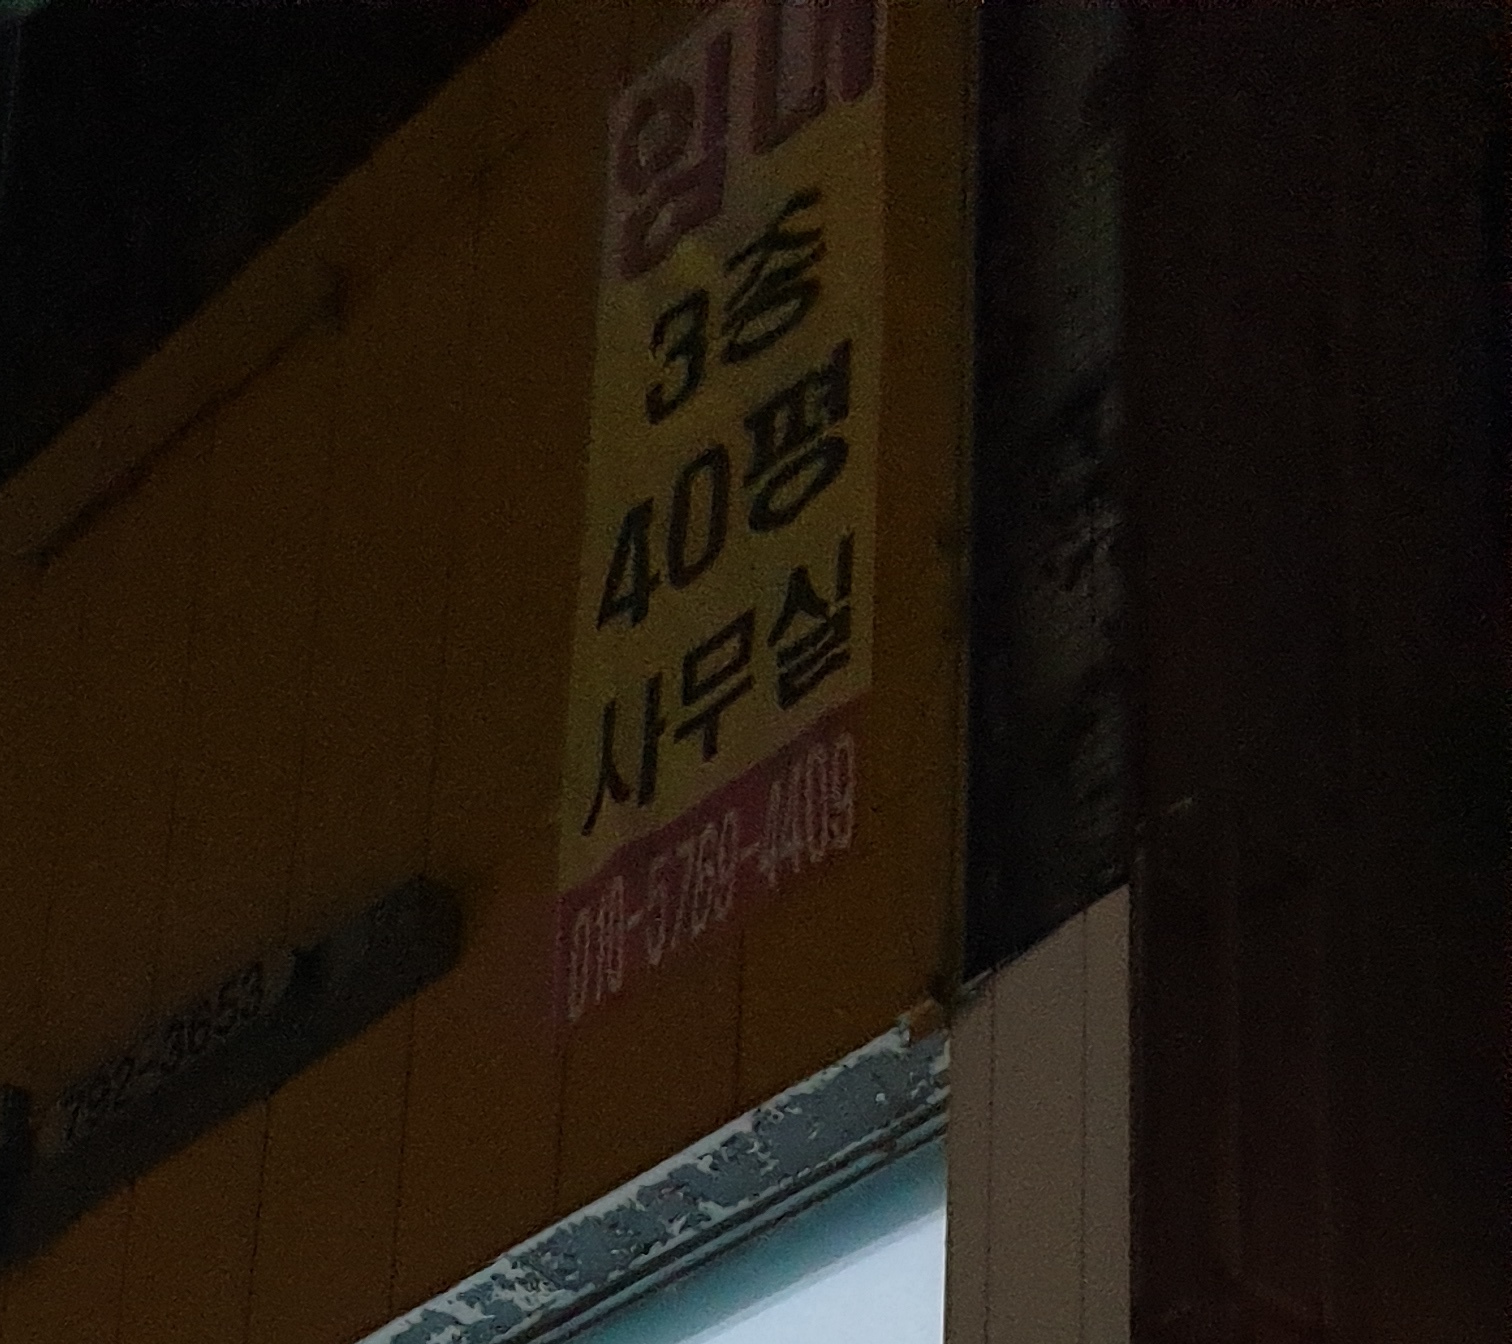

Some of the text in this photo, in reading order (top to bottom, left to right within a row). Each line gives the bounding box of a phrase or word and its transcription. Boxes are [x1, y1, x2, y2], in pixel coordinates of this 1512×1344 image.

[645, 187, 828, 427] 3층
[596, 338, 852, 632] 40평
[582, 529, 853, 838] 사무실
